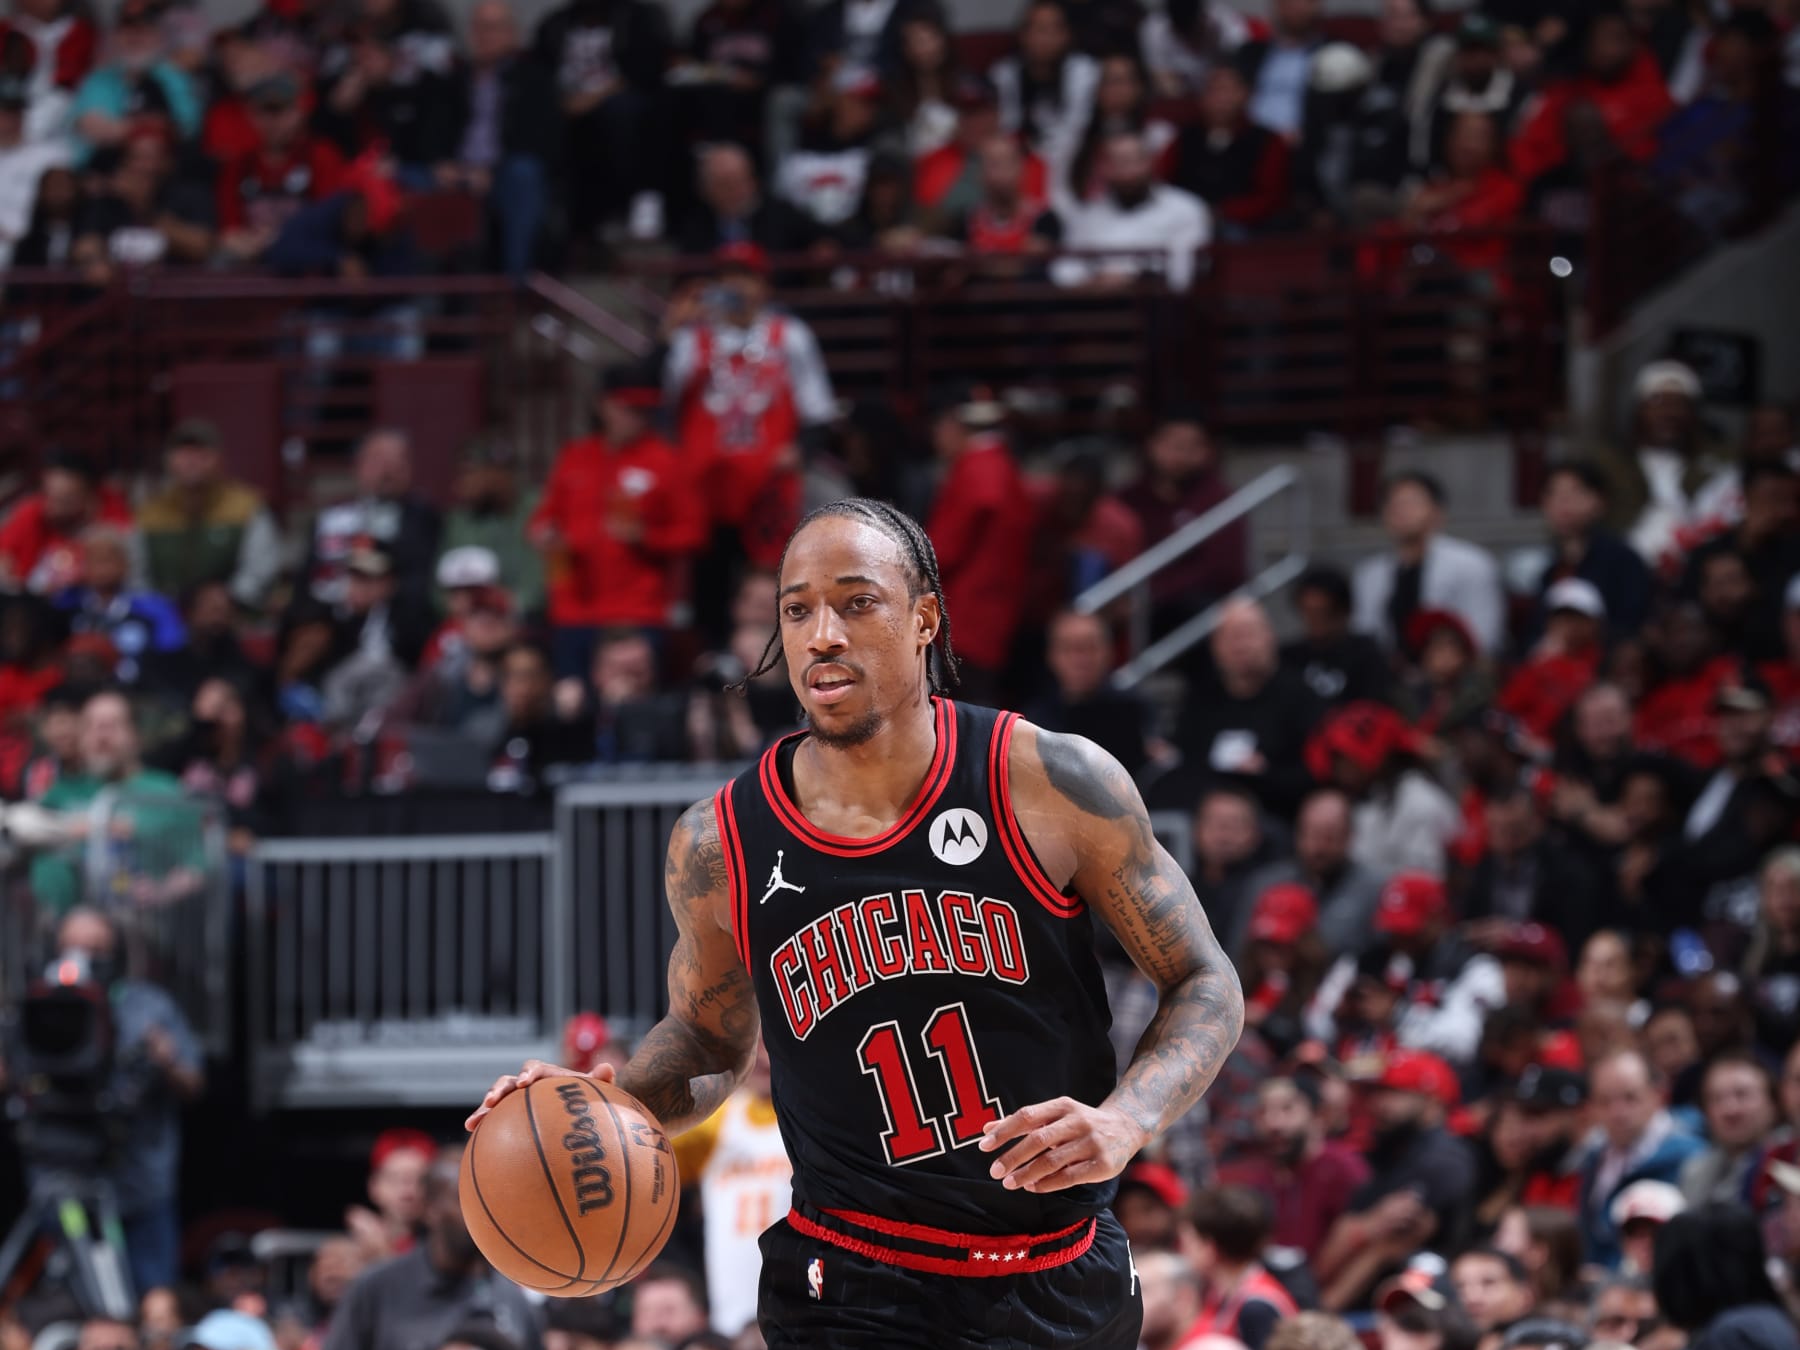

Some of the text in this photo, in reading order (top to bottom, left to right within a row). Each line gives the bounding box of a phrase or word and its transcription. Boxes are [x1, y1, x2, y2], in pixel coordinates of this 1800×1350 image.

[770, 889, 1030, 1041] CHICAGO
[555, 1082, 615, 1217] Wilson
[856, 1001, 1005, 1166] 11
